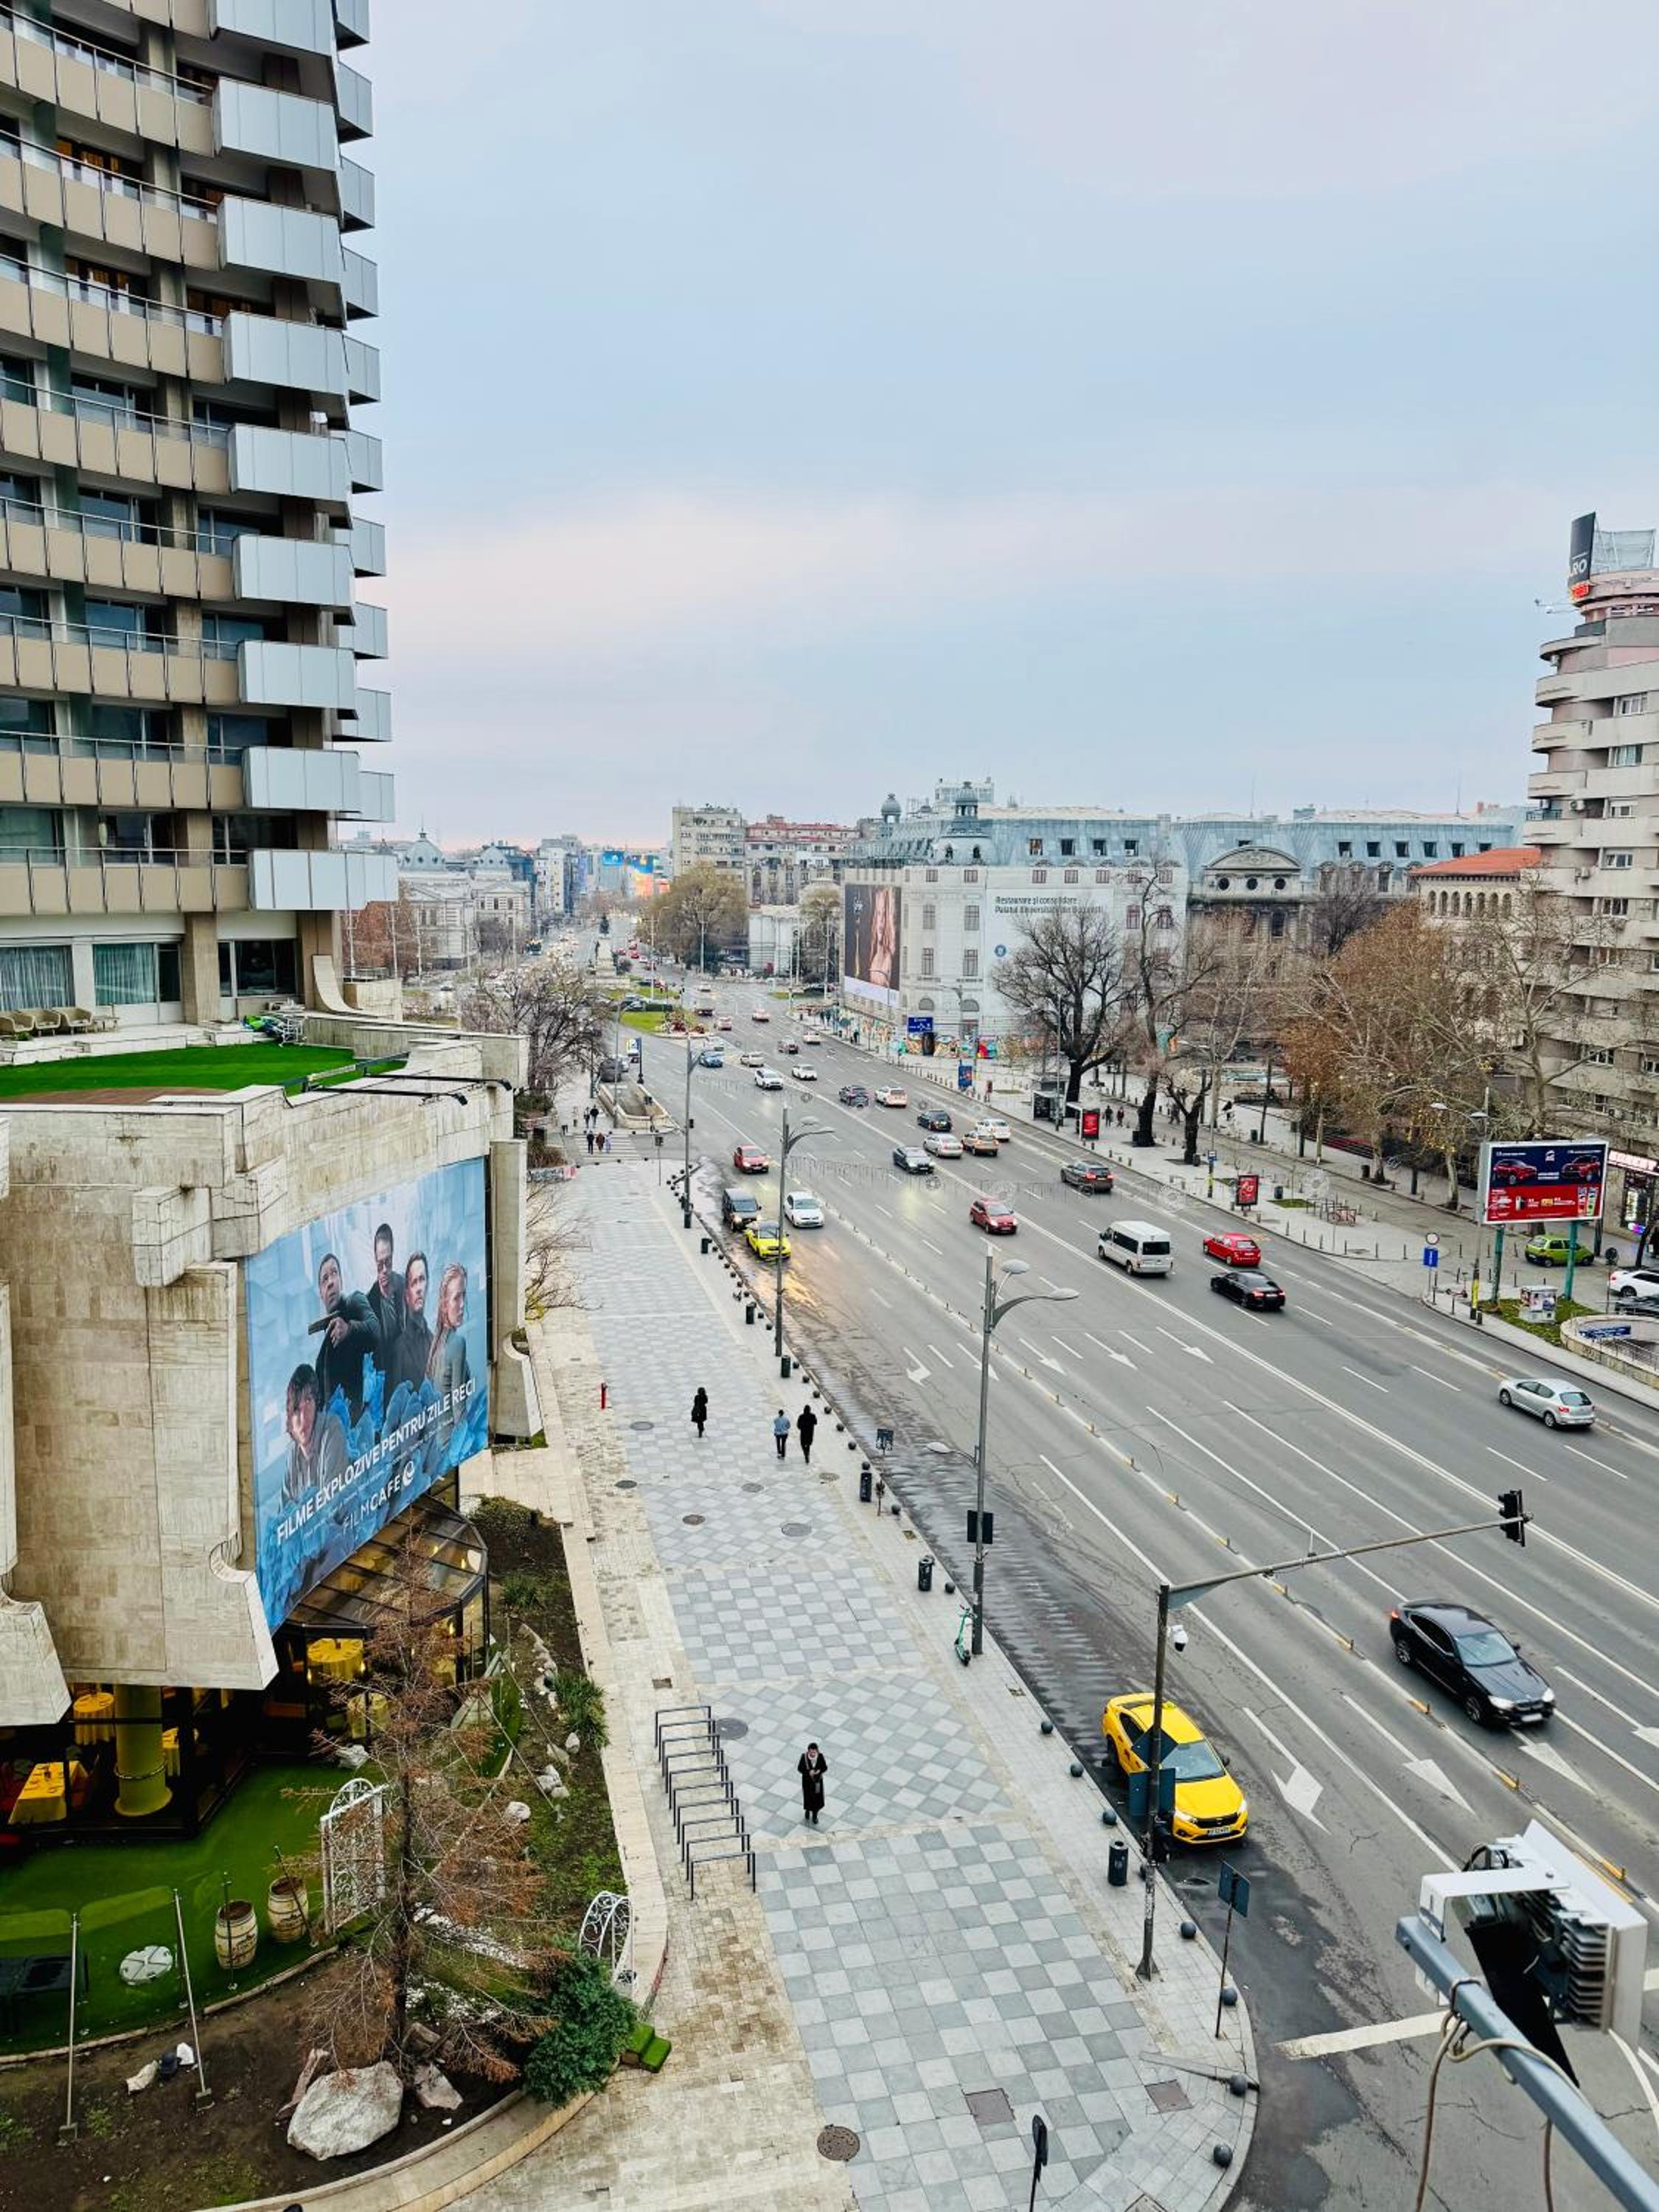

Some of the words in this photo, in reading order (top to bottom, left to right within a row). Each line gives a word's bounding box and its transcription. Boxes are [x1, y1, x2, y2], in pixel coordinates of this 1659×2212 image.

[277, 1498, 313, 1545] FILME
[316, 1444, 380, 1511] EXPLOZIVE
[380, 1410, 425, 1458] PENTRU
[427, 1393, 451, 1424] ZILE
[452, 1379, 476, 1406] RECI
